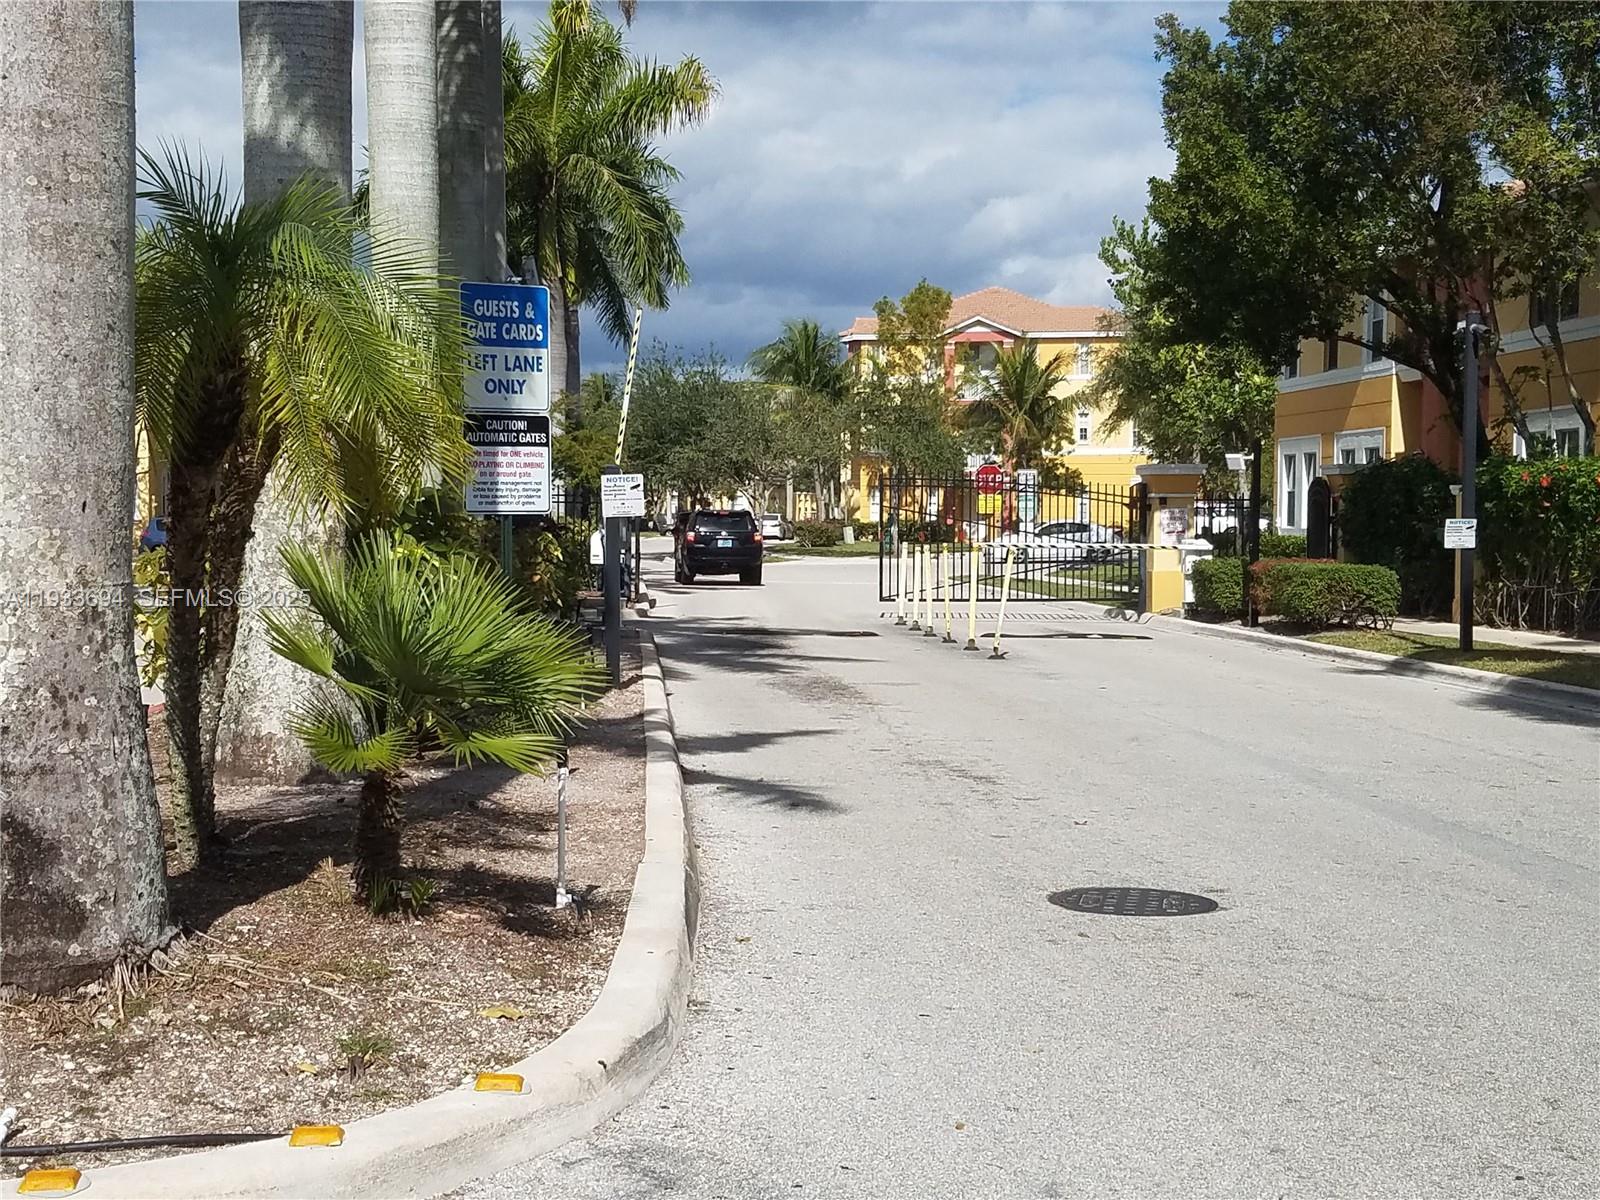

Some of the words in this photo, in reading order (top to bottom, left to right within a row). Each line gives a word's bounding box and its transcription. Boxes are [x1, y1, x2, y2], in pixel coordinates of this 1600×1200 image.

[473, 299, 520, 319] GUESTS
[525, 302, 535, 319] &
[467, 321, 497, 339] GATE
[502, 323, 544, 341] CARDS
[504, 355, 543, 372] LANE
[484, 378, 527, 395] ONLY
[486, 420, 528, 431] CAUTION!
[466, 432, 518, 443] AUTOMATIC
[519, 433, 547, 443] GATES
